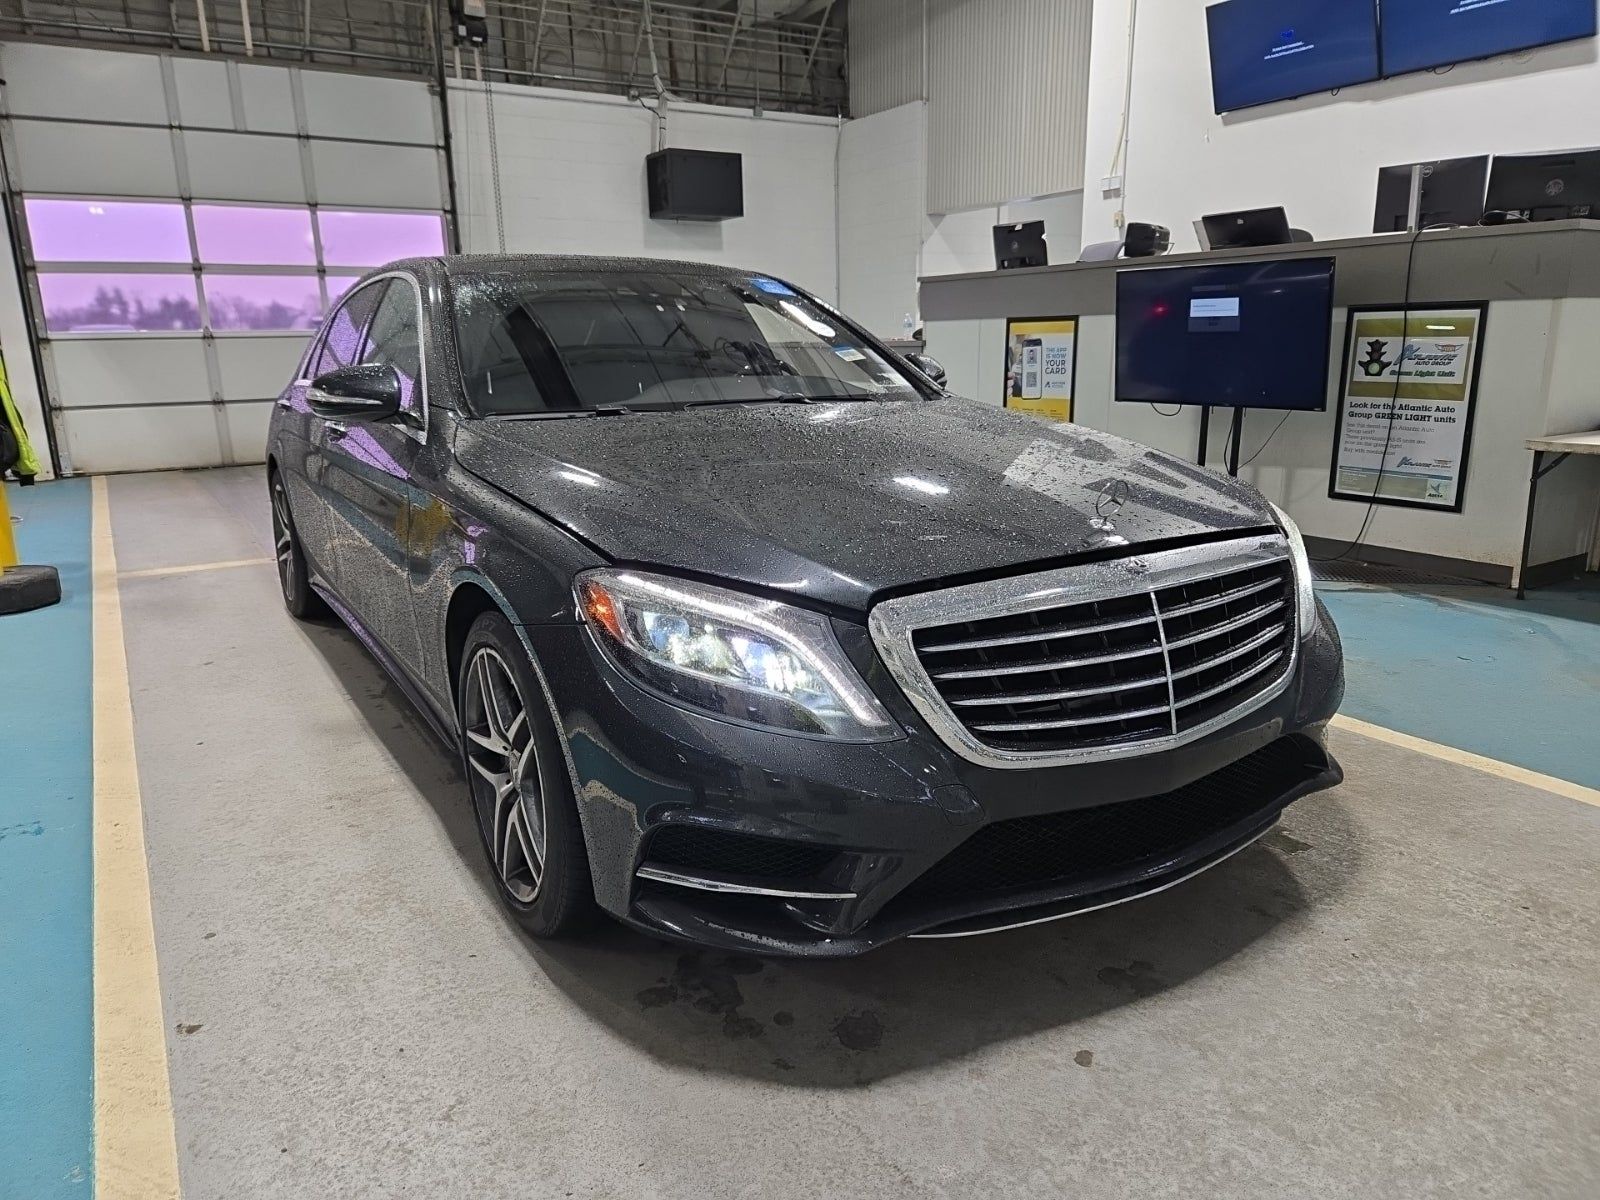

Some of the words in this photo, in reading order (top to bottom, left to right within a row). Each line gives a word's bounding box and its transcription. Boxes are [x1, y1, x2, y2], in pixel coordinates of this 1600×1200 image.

[1398, 404, 1433, 412] Atlantic
[1348, 411, 1373, 420] Group
[1374, 412, 1403, 420] GREEN
[1404, 414, 1432, 422] LIGHT
[1434, 415, 1456, 424] units
